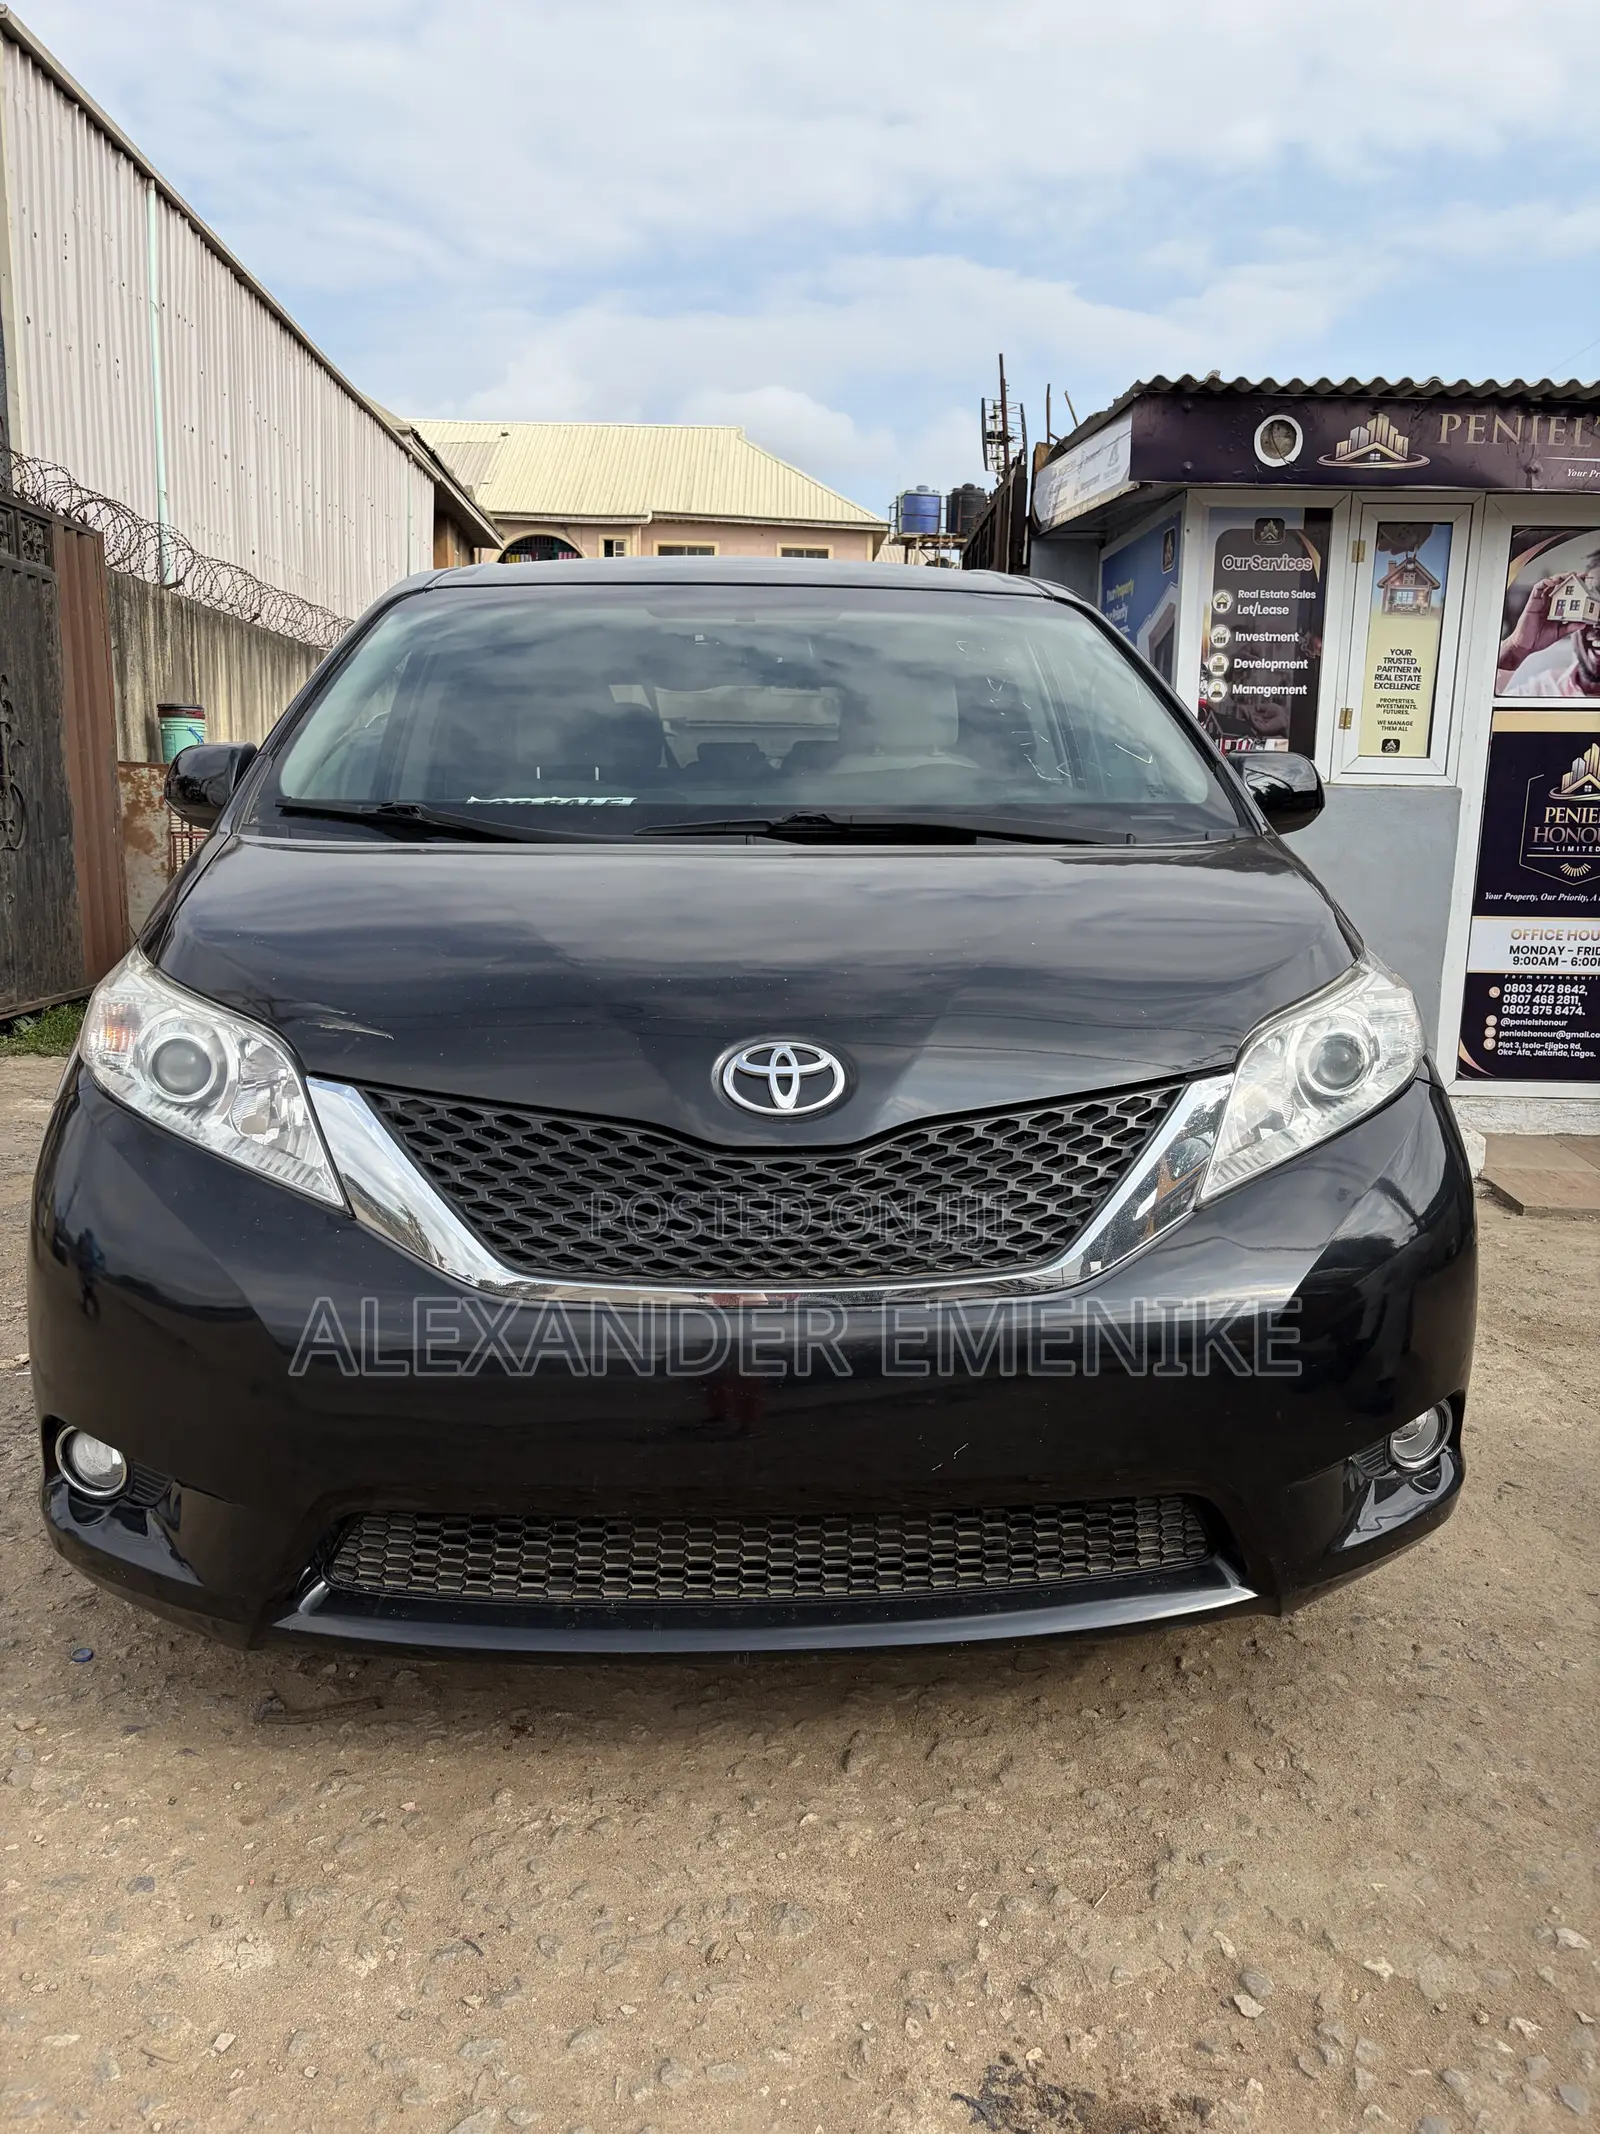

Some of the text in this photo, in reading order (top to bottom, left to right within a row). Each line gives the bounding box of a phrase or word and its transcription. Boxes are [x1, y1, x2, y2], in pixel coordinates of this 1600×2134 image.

[1567, 468, 1587, 478] Your
[1221, 553, 1313, 571] Our Services
[1238, 589, 1316, 599] Real Estate Sales
[1237, 602, 1290, 617] Let/Lease
[1235, 631, 1300, 642] Investment
[1390, 648, 1412, 656] YOUR
[1233, 658, 1309, 672] Development
[1383, 657, 1417, 665] TRUSTED
[1376, 665, 1412, 673] PARTNER
[1394, 674, 1422, 682] ESTATE
[1232, 684, 1308, 698] Management
[1374, 682, 1421, 691] EXCELLENCE
[1543, 806, 1600, 824] PENIE
[1484, 892, 1503, 900] Your
[1504, 892, 1538, 902] Property,
[1540, 893, 1557, 901] Our
[1557, 893, 1589, 903] Priority,
[1510, 928, 1600, 941] OFFICE HOU
[1509, 945, 1566, 955] MONDAY
[1512, 956, 1559, 966] 9:00AM
[1504, 983, 1588, 996] 0803 472 8642,
[1503, 994, 1581, 1006] 0807 468 2811,
[1501, 1005, 1585, 1016] 0802 875 8474.
[1498, 1041, 1514, 1049] Plot
[1570, 1050, 1597, 1059] Lagos.
